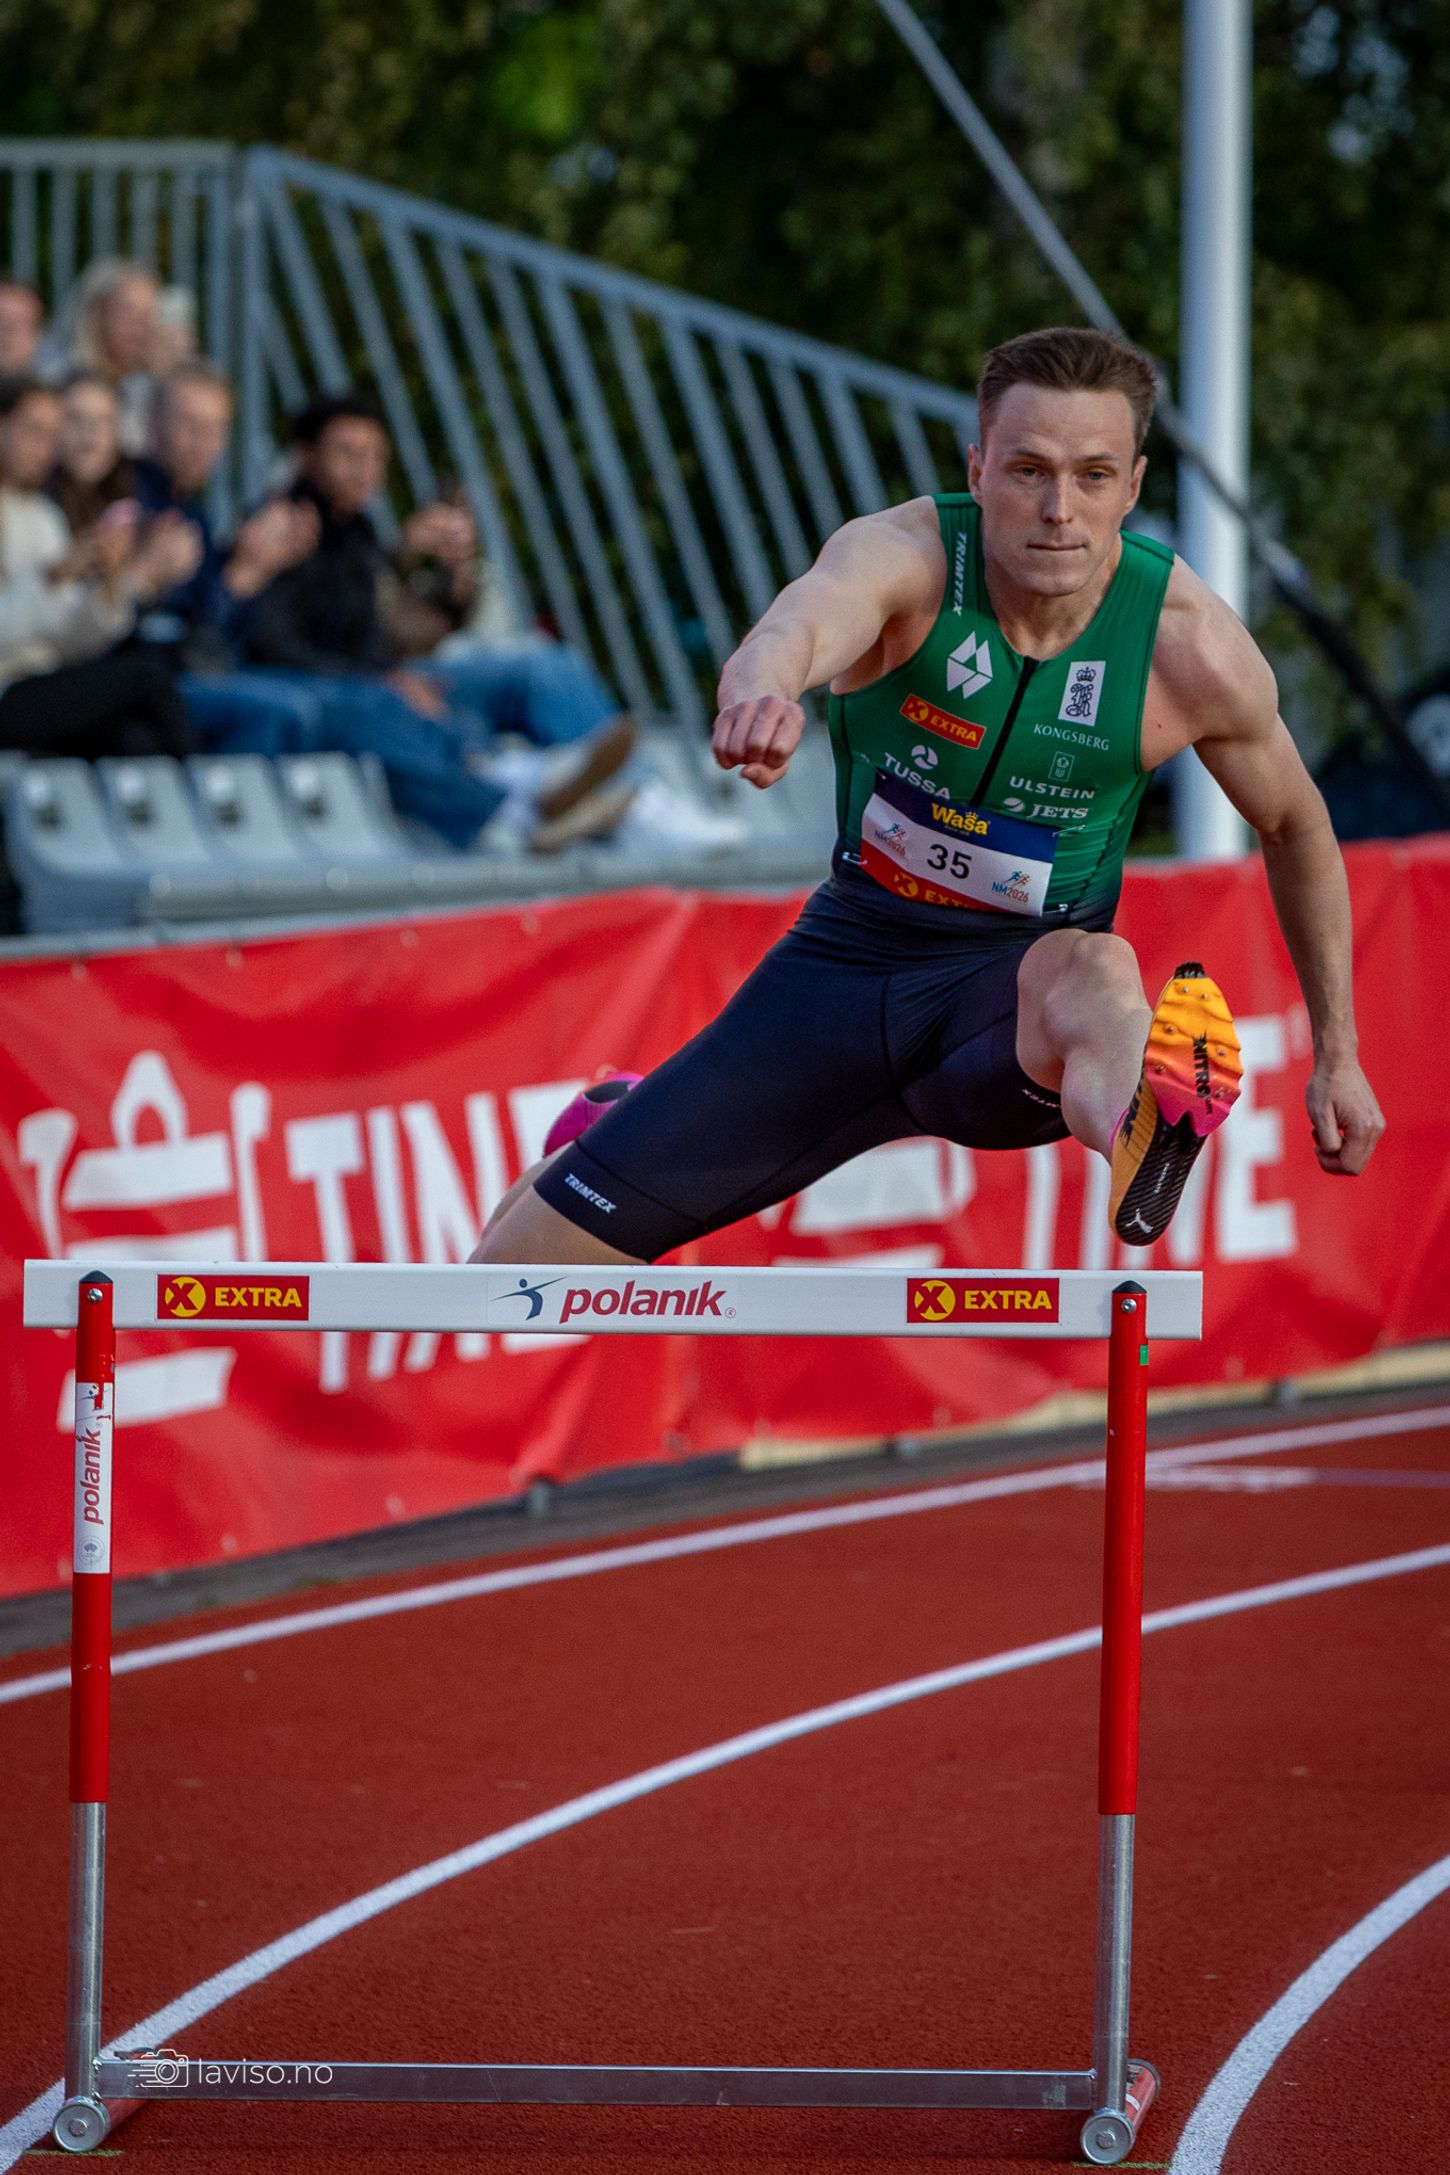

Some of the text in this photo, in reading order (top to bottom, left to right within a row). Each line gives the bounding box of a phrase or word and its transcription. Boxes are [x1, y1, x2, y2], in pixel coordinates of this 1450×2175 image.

[952, 531, 967, 617] TRIMTEX
[930, 714, 977, 742] EXTRA
[1033, 723, 1110, 751] KONGSBERG
[884, 751, 951, 800] TUSSA
[1009, 775, 1096, 800] ULSTEIN
[931, 803, 988, 836] Wasa
[1026, 803, 1089, 820] JETS
[926, 843, 972, 879] 35
[925, 889, 987, 911] EXT
[991, 881, 1030, 903] NM2026
[1192, 1030, 1211, 1099] NITRO
[564, 1172, 617, 1214] TRIMTEX
[215, 1286, 302, 1308] EXTRA
[559, 1280, 727, 1324] polanik
[964, 1290, 1052, 1310] EXTRA
[79, 1427, 105, 1525] polanik
